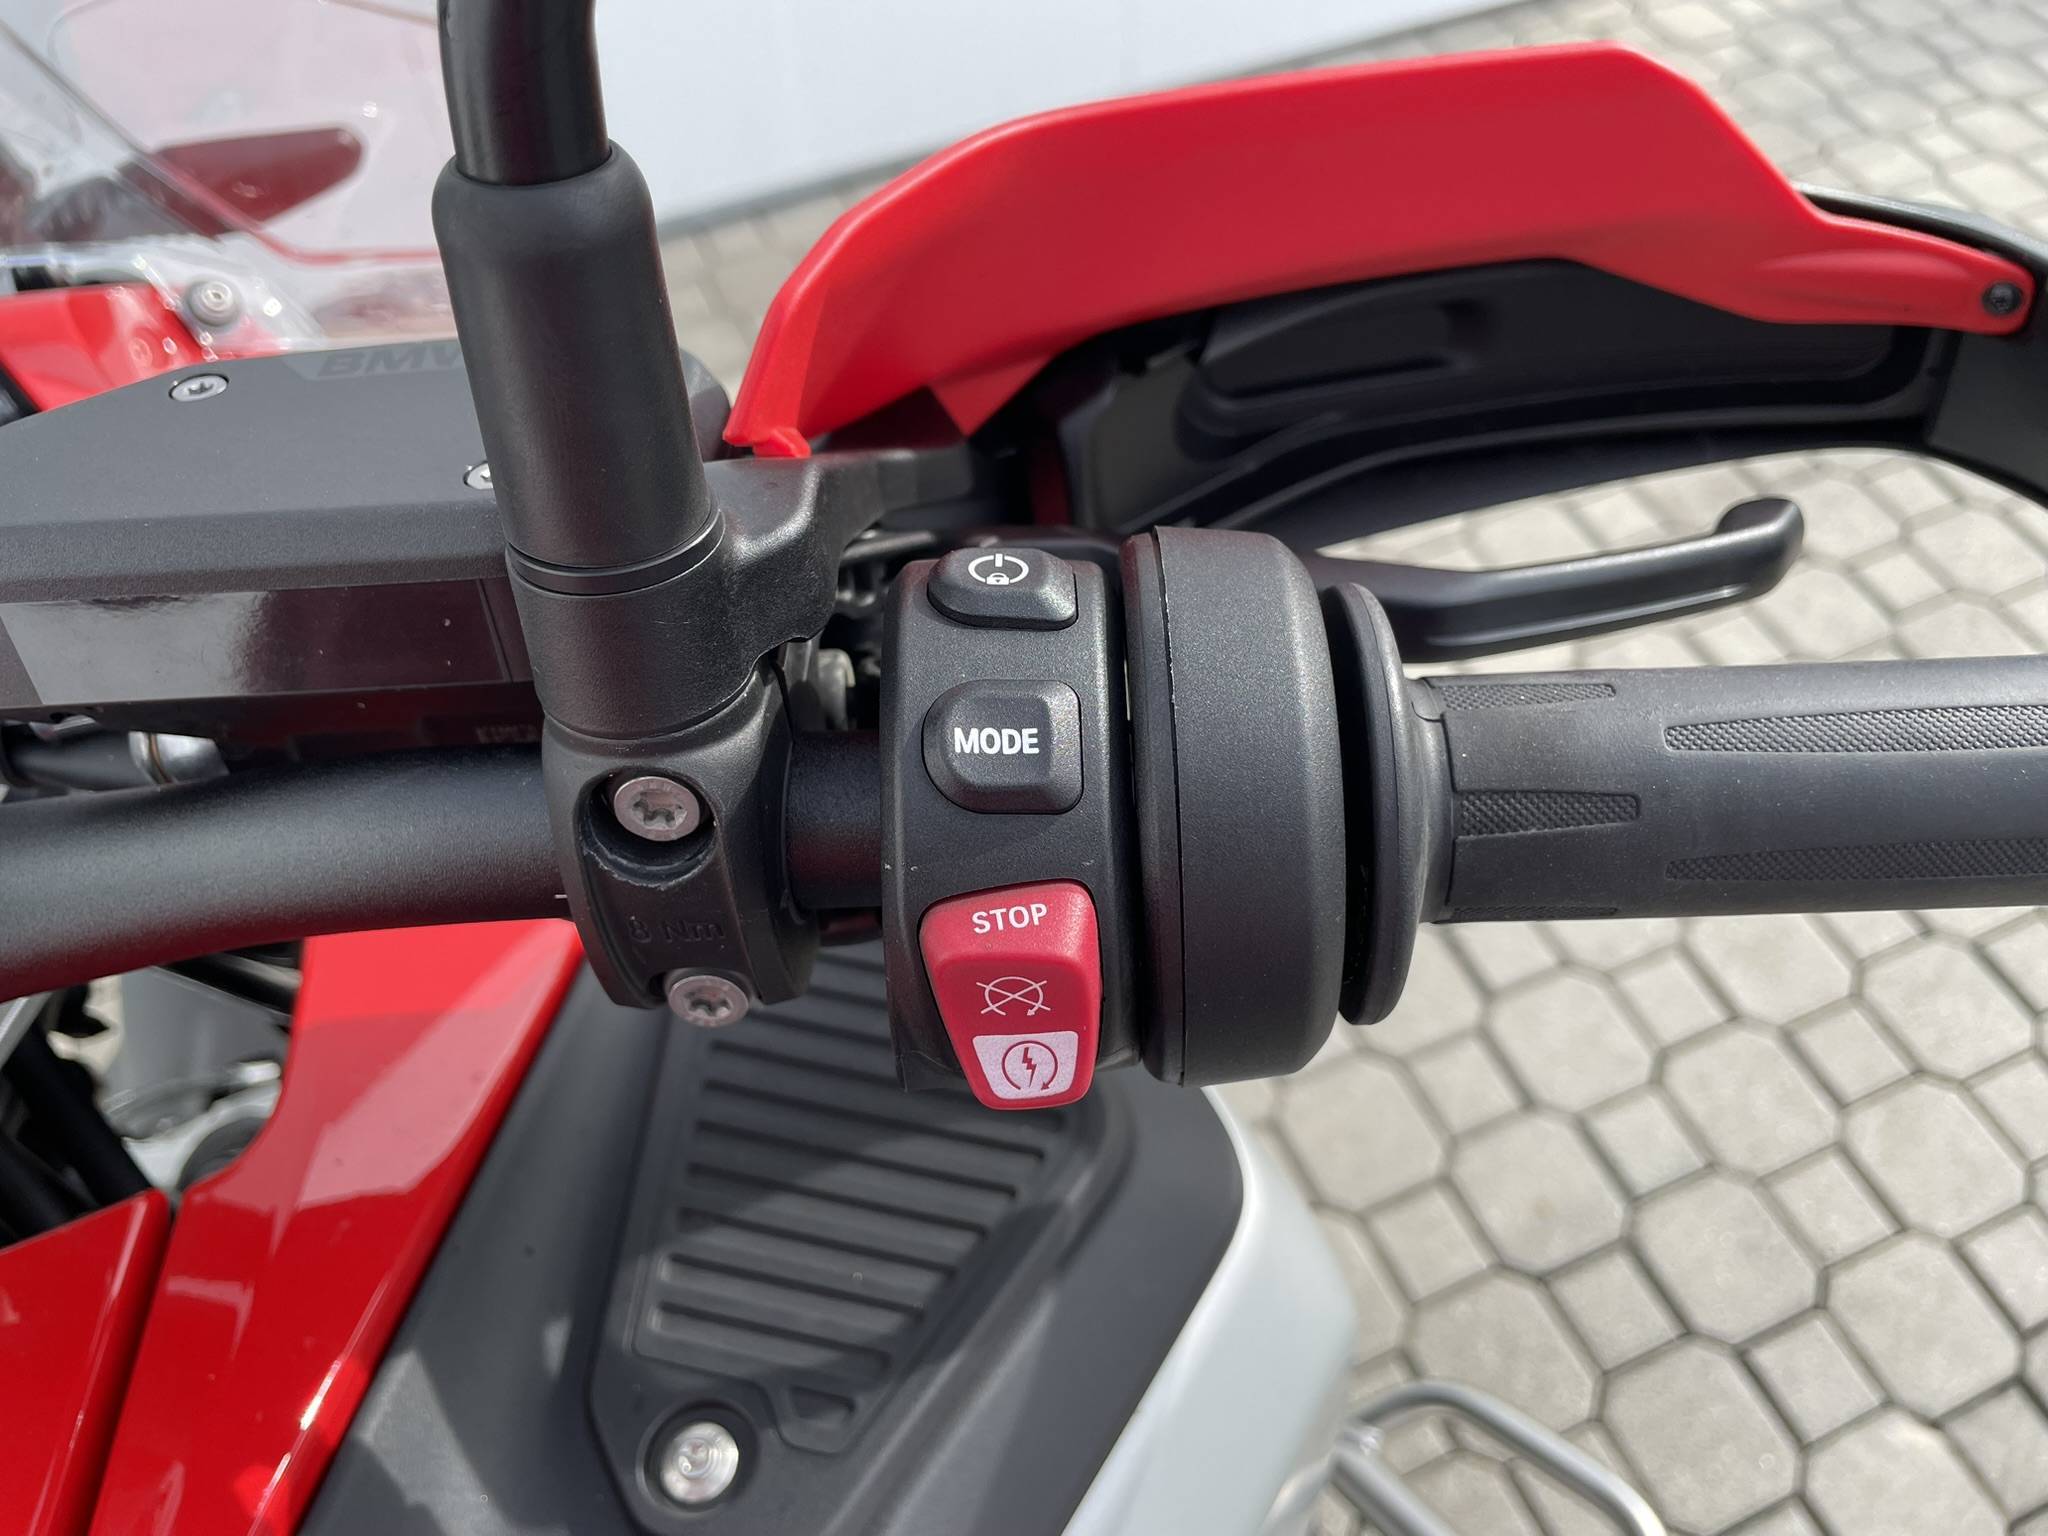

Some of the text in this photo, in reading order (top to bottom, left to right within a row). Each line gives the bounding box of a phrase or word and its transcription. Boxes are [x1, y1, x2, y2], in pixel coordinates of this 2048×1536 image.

[953, 727, 1040, 755] MODE
[628, 916, 727, 943] 8 Nm
[971, 903, 1048, 934] STOP
